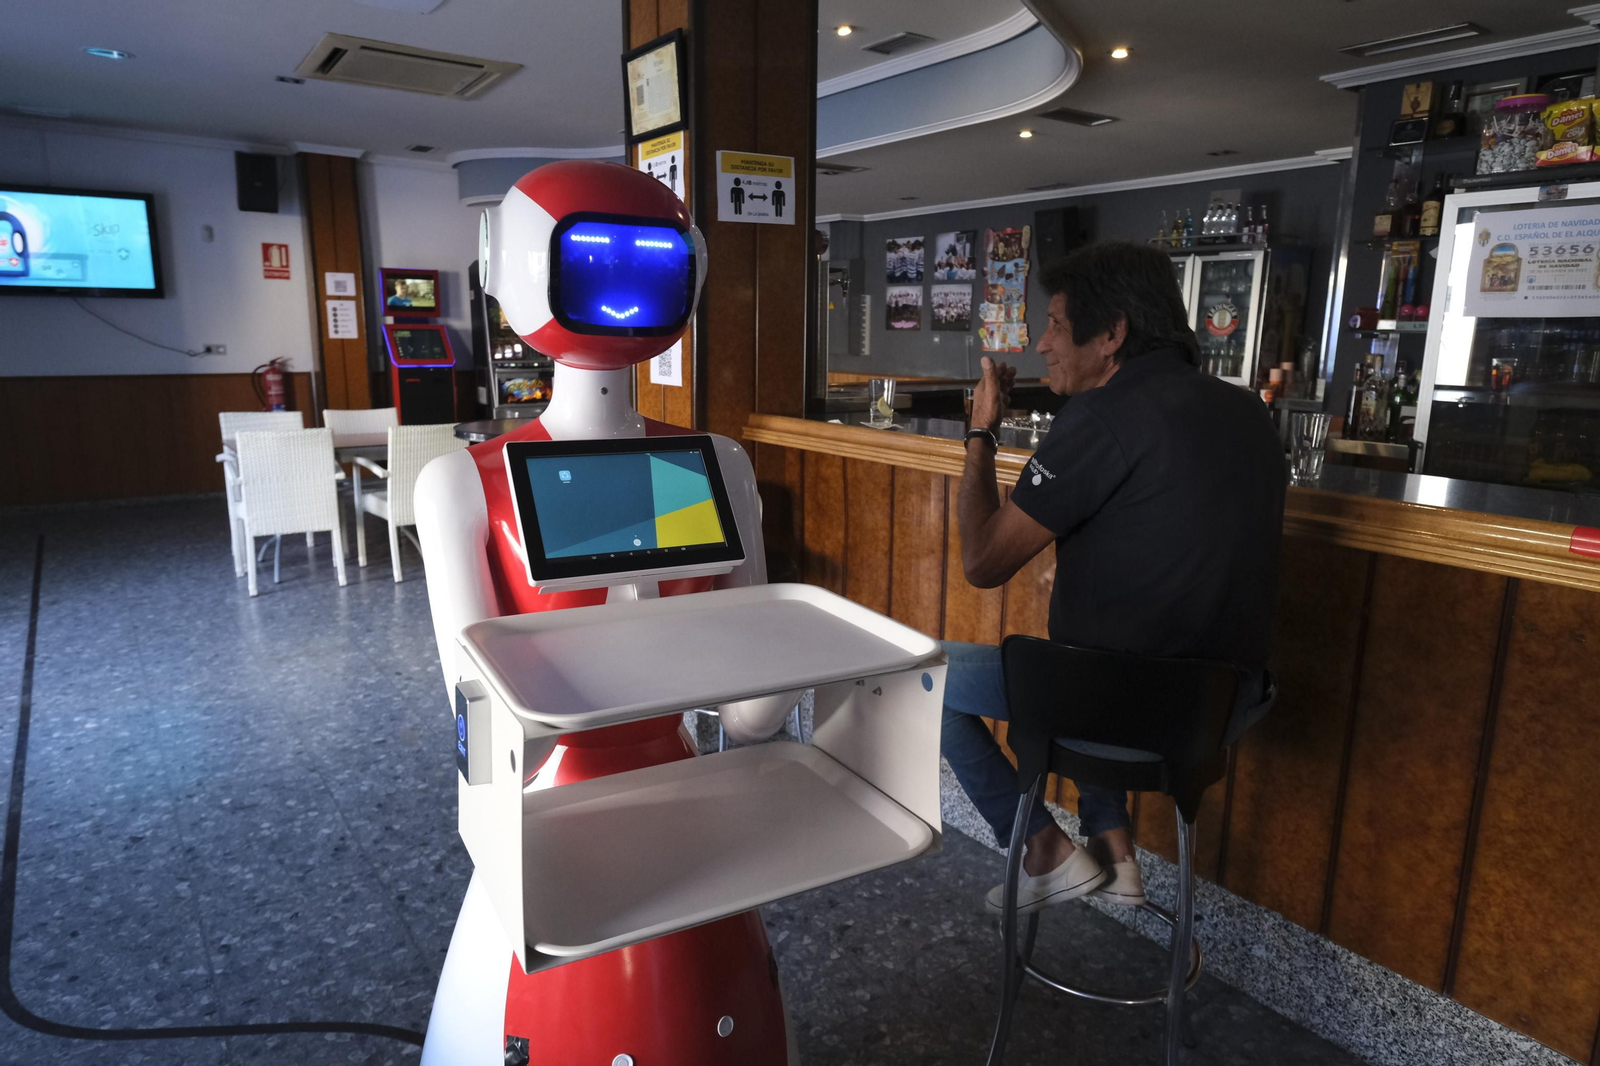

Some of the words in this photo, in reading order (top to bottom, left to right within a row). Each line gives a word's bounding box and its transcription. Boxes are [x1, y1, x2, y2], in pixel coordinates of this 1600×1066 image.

[1552, 110, 1583, 127] Damel
[1547, 146, 1577, 159] Damel
[1513, 222, 1546, 230] LOTERIA
[1548, 221, 1559, 229] DE
[1561, 218, 1600, 227] NAVIDAD
[1514, 231, 1550, 240] ESPAÑOL
[1529, 244, 1595, 256] 53656
